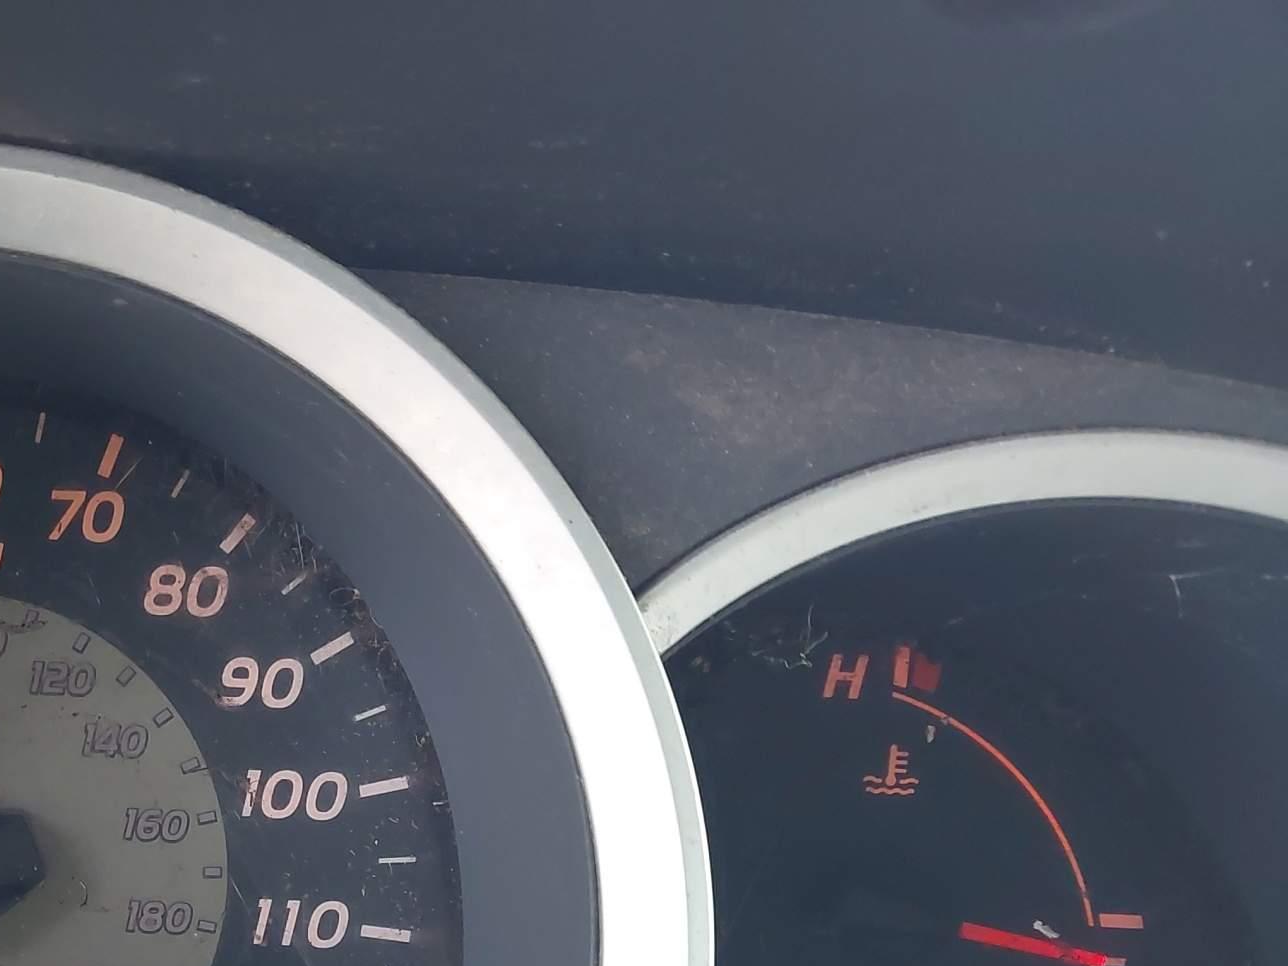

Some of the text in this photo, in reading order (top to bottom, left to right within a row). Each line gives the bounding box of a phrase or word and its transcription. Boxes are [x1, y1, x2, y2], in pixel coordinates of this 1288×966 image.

[48, 488, 125, 543] 70
[143, 564, 229, 618] 80
[29, 660, 97, 697] 120
[219, 656, 304, 708] 90
[822, 654, 869, 699] H
[82, 721, 149, 760] 140
[242, 769, 348, 821] 100
[122, 807, 189, 843] 160
[125, 900, 193, 935] 180
[253, 898, 350, 949] 110
